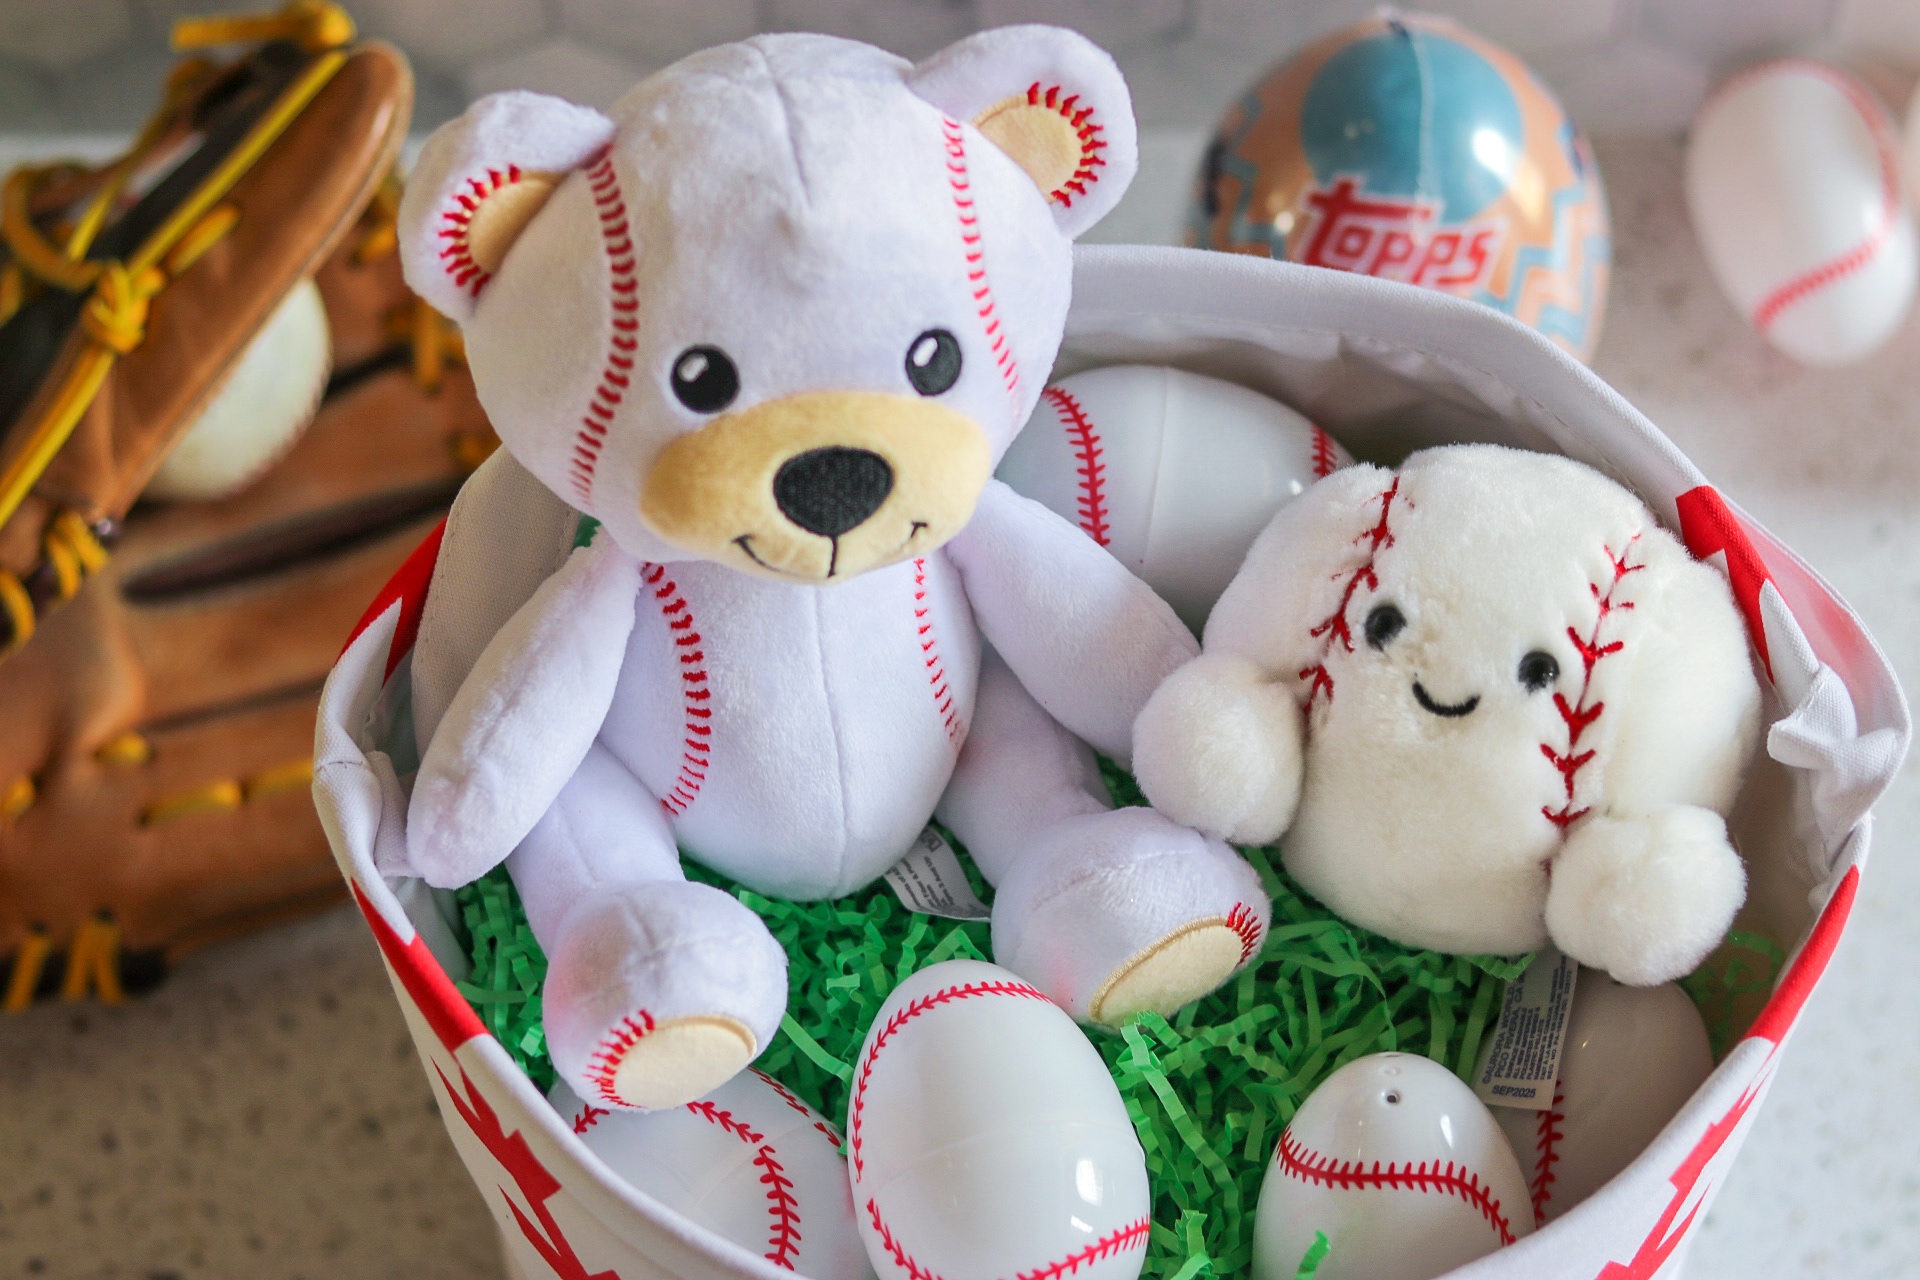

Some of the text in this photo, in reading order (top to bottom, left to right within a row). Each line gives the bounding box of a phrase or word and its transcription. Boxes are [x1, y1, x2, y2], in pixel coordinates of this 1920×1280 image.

[1494, 1052, 1509, 1077] PICO
[1514, 987, 1523, 1002] CA
[1492, 1084, 1536, 1098] SEP2025
